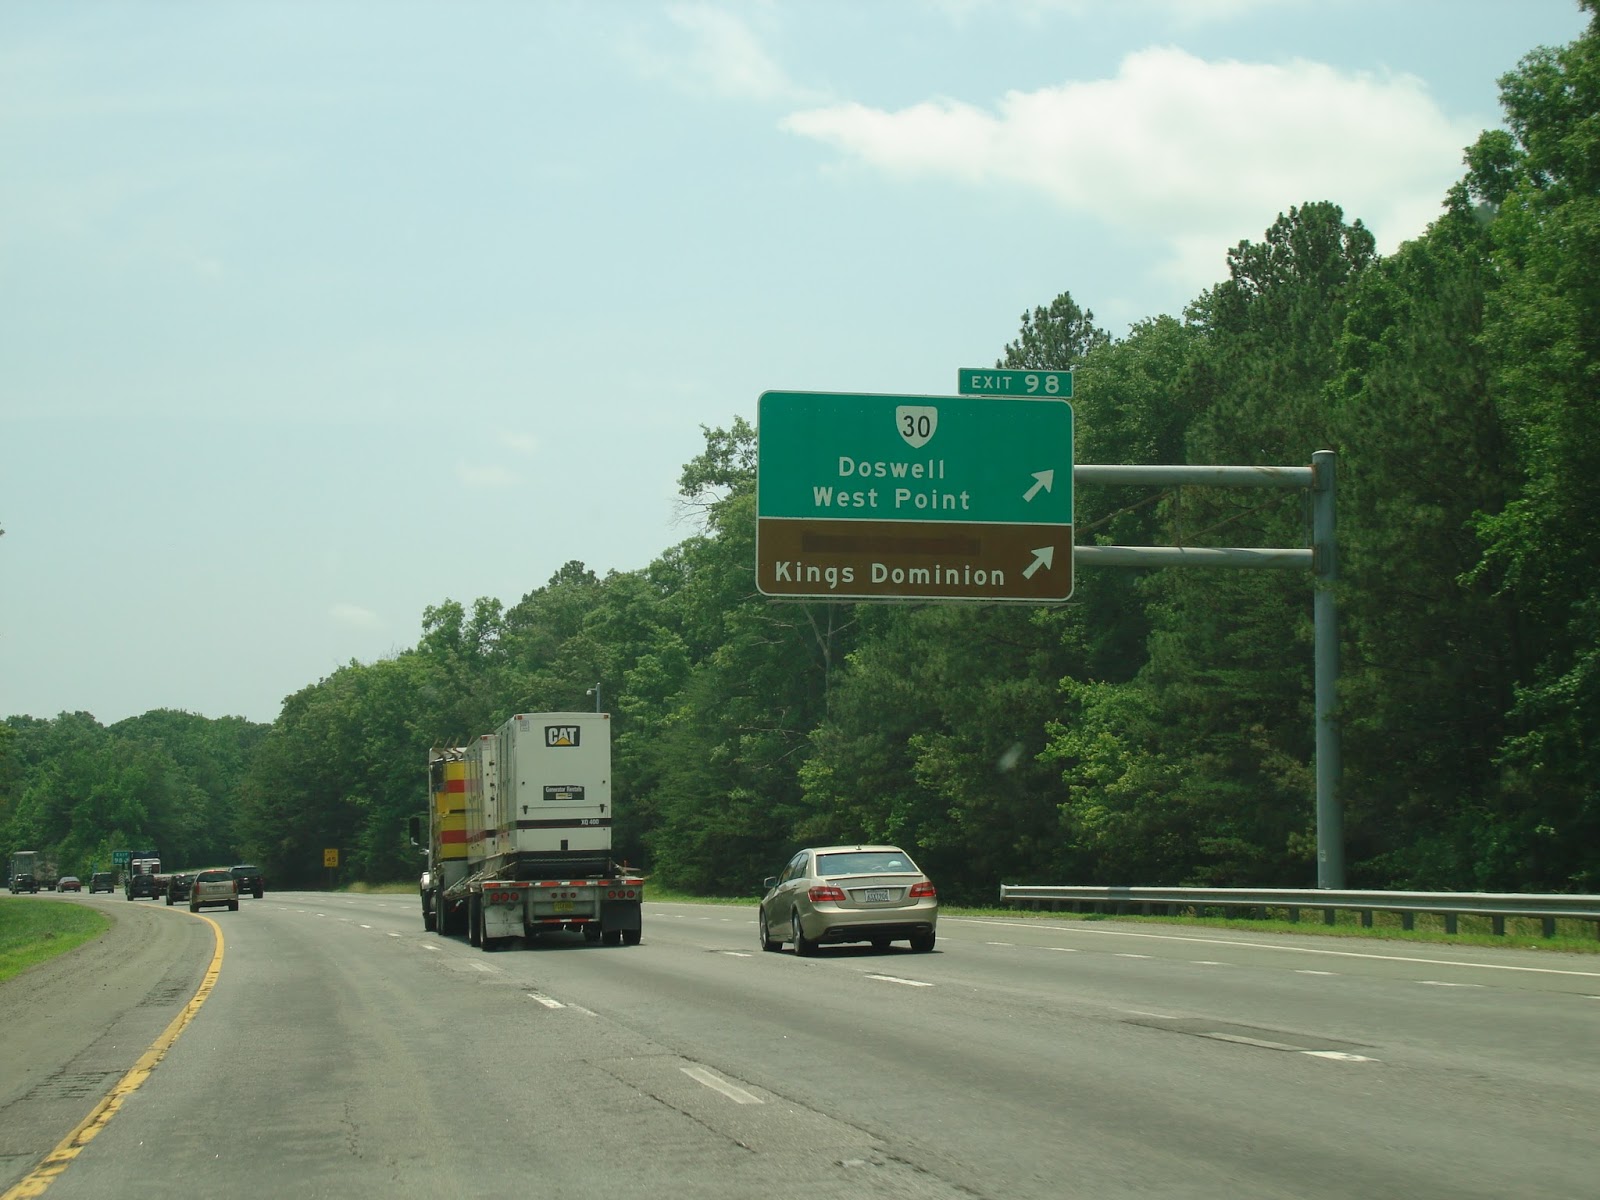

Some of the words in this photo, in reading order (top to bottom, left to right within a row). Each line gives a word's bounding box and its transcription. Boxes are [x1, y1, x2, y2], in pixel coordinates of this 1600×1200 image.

[971, 375, 1012, 389] EXIT
[1024, 374, 1060, 394] 98
[902, 415, 931, 438] 30
[838, 456, 945, 480] Doswell
[813, 486, 878, 508] West
[895, 488, 970, 511] Point
[775, 561, 855, 589] Kings
[871, 562, 1005, 586] Dominion
[548, 727, 577, 745] CAT
